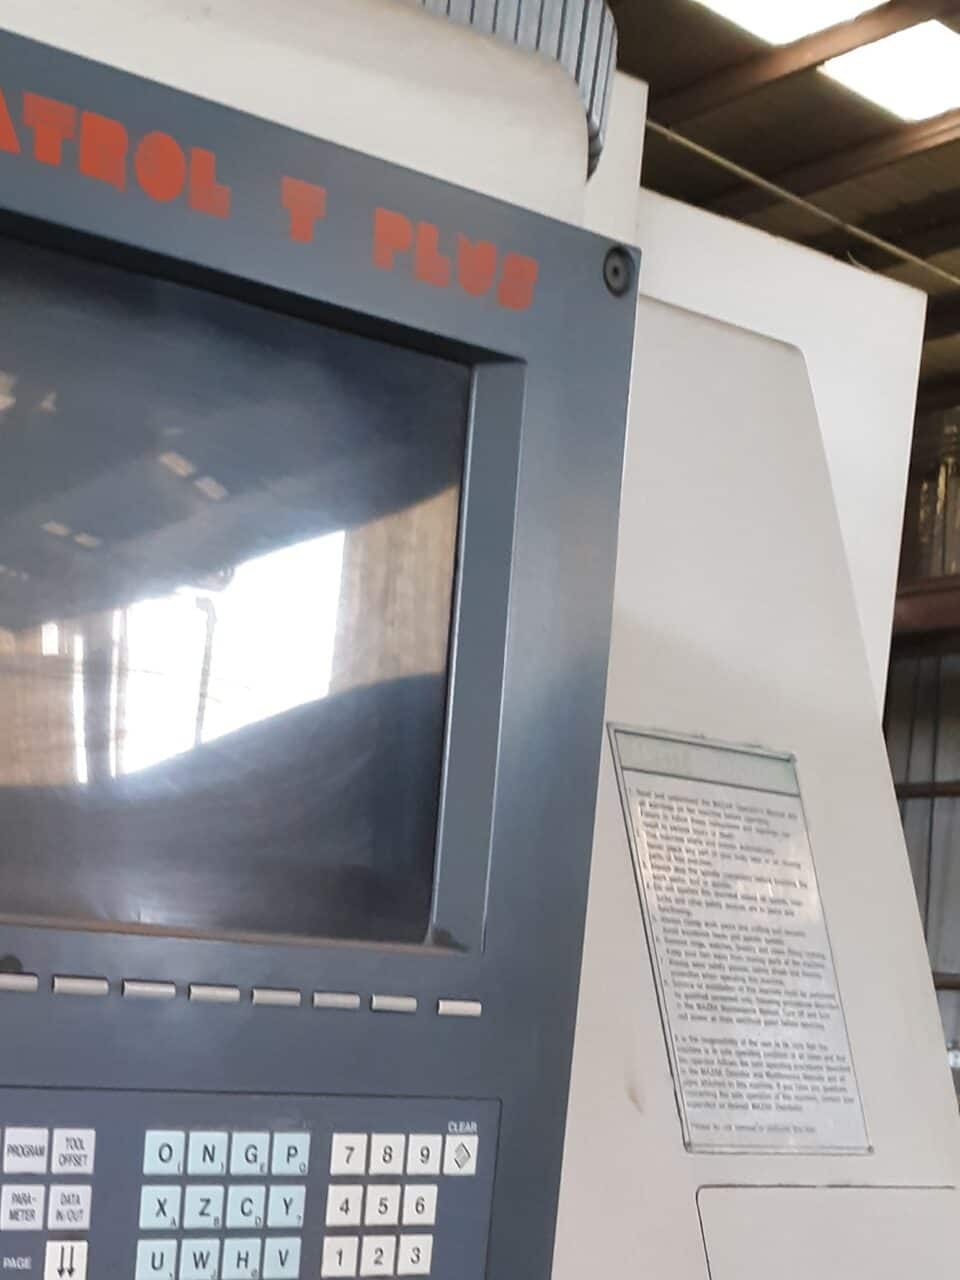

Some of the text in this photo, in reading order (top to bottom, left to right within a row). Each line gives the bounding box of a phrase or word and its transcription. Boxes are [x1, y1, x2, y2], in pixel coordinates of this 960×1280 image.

[281, 177, 326, 244] T
[374, 207, 539, 312] PLUS
[448, 1122, 477, 1133] CLEAR
[58, 1153, 88, 1166] OFFSET
[202, 1144, 215, 1162] N
[245, 1145, 258, 1163] G
[287, 1146, 298, 1163] P
[343, 1146, 355, 1164] 7
[383, 1146, 393, 1163] 8
[420, 1146, 430, 1164] 9
[155, 1199, 168, 1217] X
[198, 1199, 211, 1216] Z
[240, 1199, 253, 1216] C
[283, 1198, 294, 1216] Y
[340, 1198, 350, 1215] 4
[378, 1197, 388, 1214] 5
[415, 1197, 425, 1214] 6
[9, 1210, 36, 1221] METER
[3, 1257, 31, 1269] PAGE
[151, 1252, 164, 1270] U
[193, 1252, 209, 1268] W
[237, 1252, 249, 1268] H
[278, 1250, 289, 1266] V
[336, 1248, 343, 1266] 1
[374, 1248, 384, 1265] 2
[410, 1247, 420, 1264] 3
